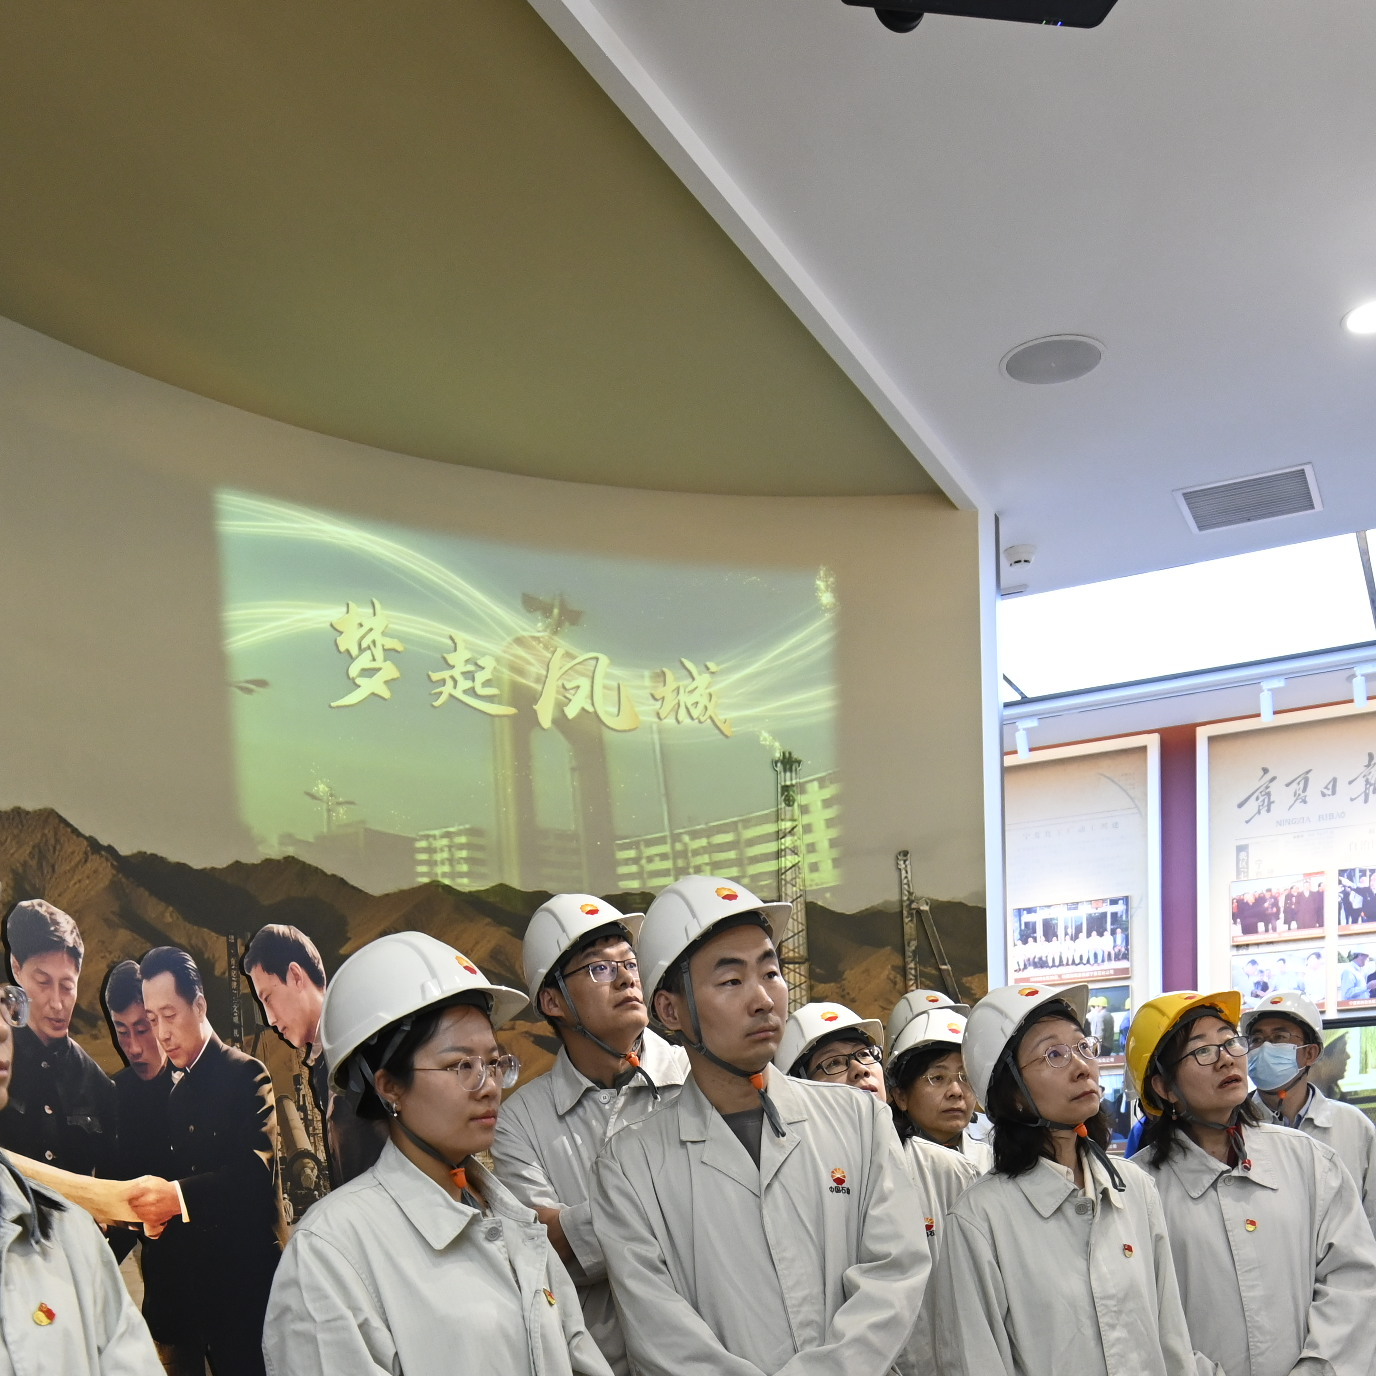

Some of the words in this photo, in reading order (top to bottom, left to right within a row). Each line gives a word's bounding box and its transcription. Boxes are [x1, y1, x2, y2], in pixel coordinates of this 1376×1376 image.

[329, 598, 733, 738] 梦起凤城
[1275, 817, 1311, 828] NINGXIA
[1318, 811, 1346, 823] RIBAO
